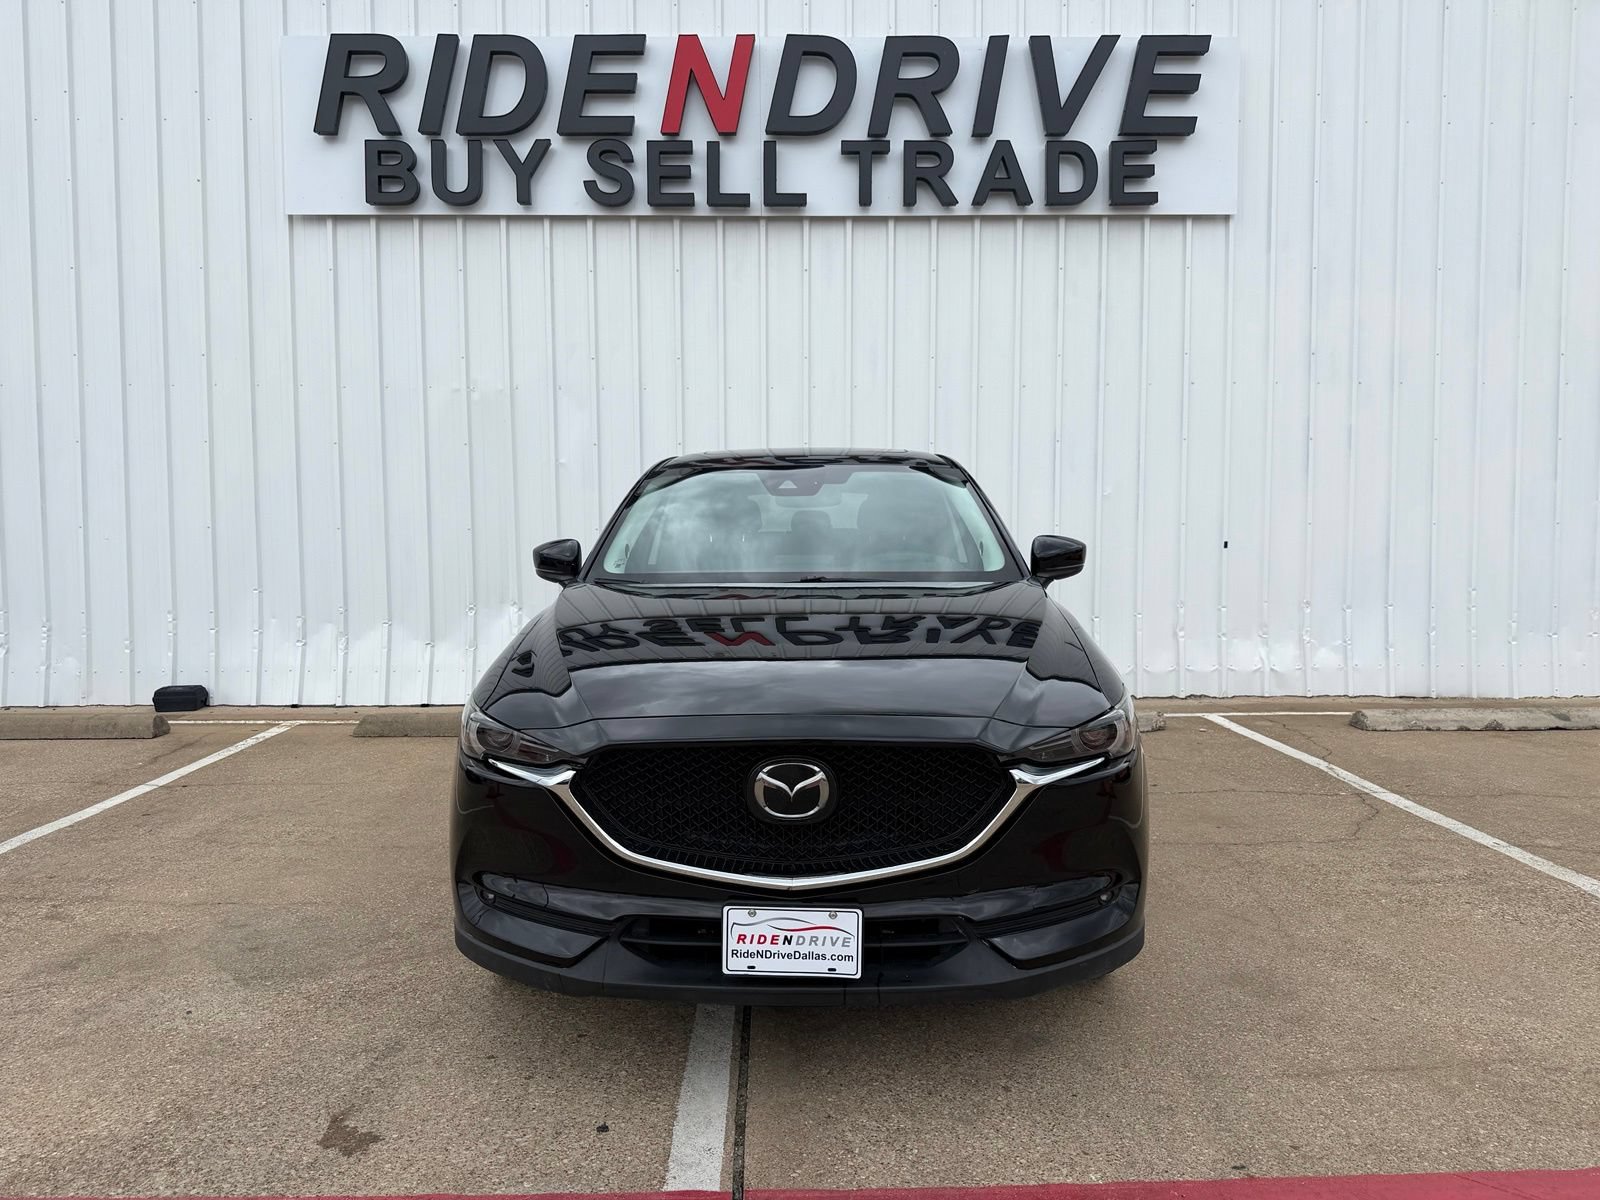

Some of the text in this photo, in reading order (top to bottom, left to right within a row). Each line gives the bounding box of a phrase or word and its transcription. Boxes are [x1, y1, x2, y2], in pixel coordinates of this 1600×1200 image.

[313, 33, 1212, 137] RIDENDRIVE
[364, 139, 1159, 208] BUY SELL TRADE
[731, 949, 854, 963] RideNDriveDallas.com
[737, 934, 851, 947] RIDENDRIVE
